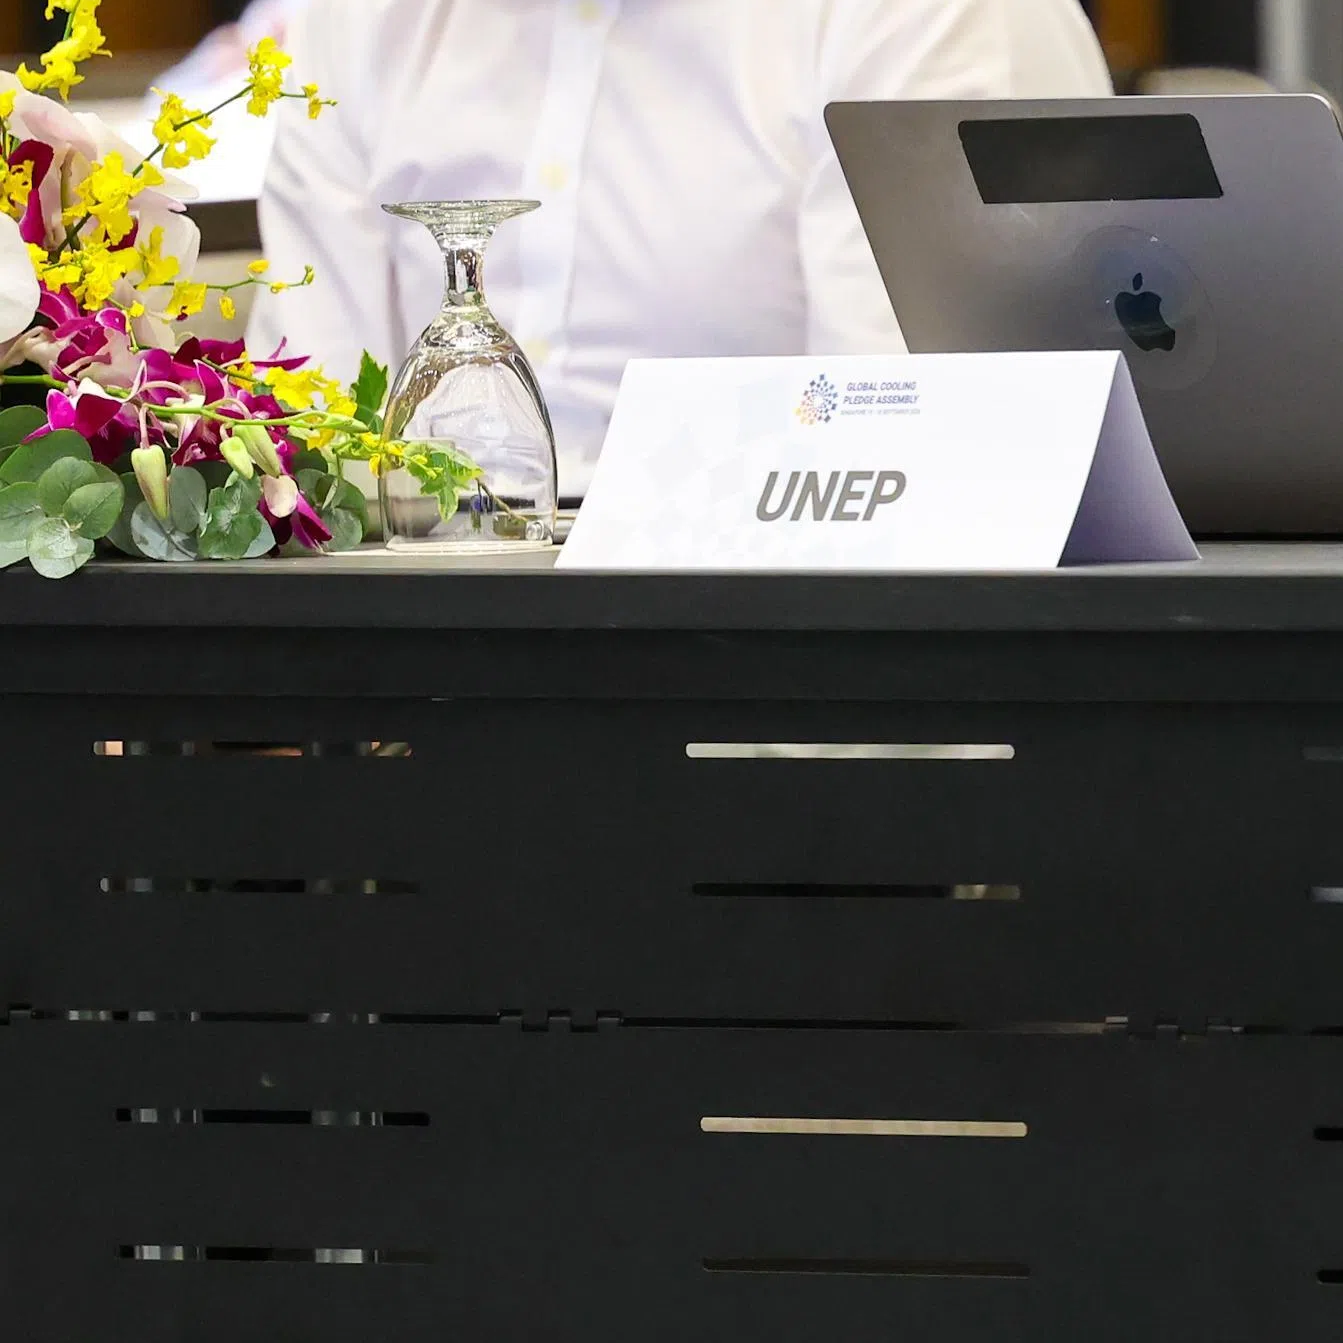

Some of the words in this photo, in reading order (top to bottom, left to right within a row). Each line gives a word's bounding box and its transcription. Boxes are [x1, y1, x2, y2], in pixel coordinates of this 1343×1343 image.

[847, 382, 878, 391] GLOBAL
[880, 381, 917, 391] COOLING
[843, 395, 876, 404] PLEDGE
[876, 395, 920, 404] ASSEMBLY
[755, 470, 907, 522] UNEP
